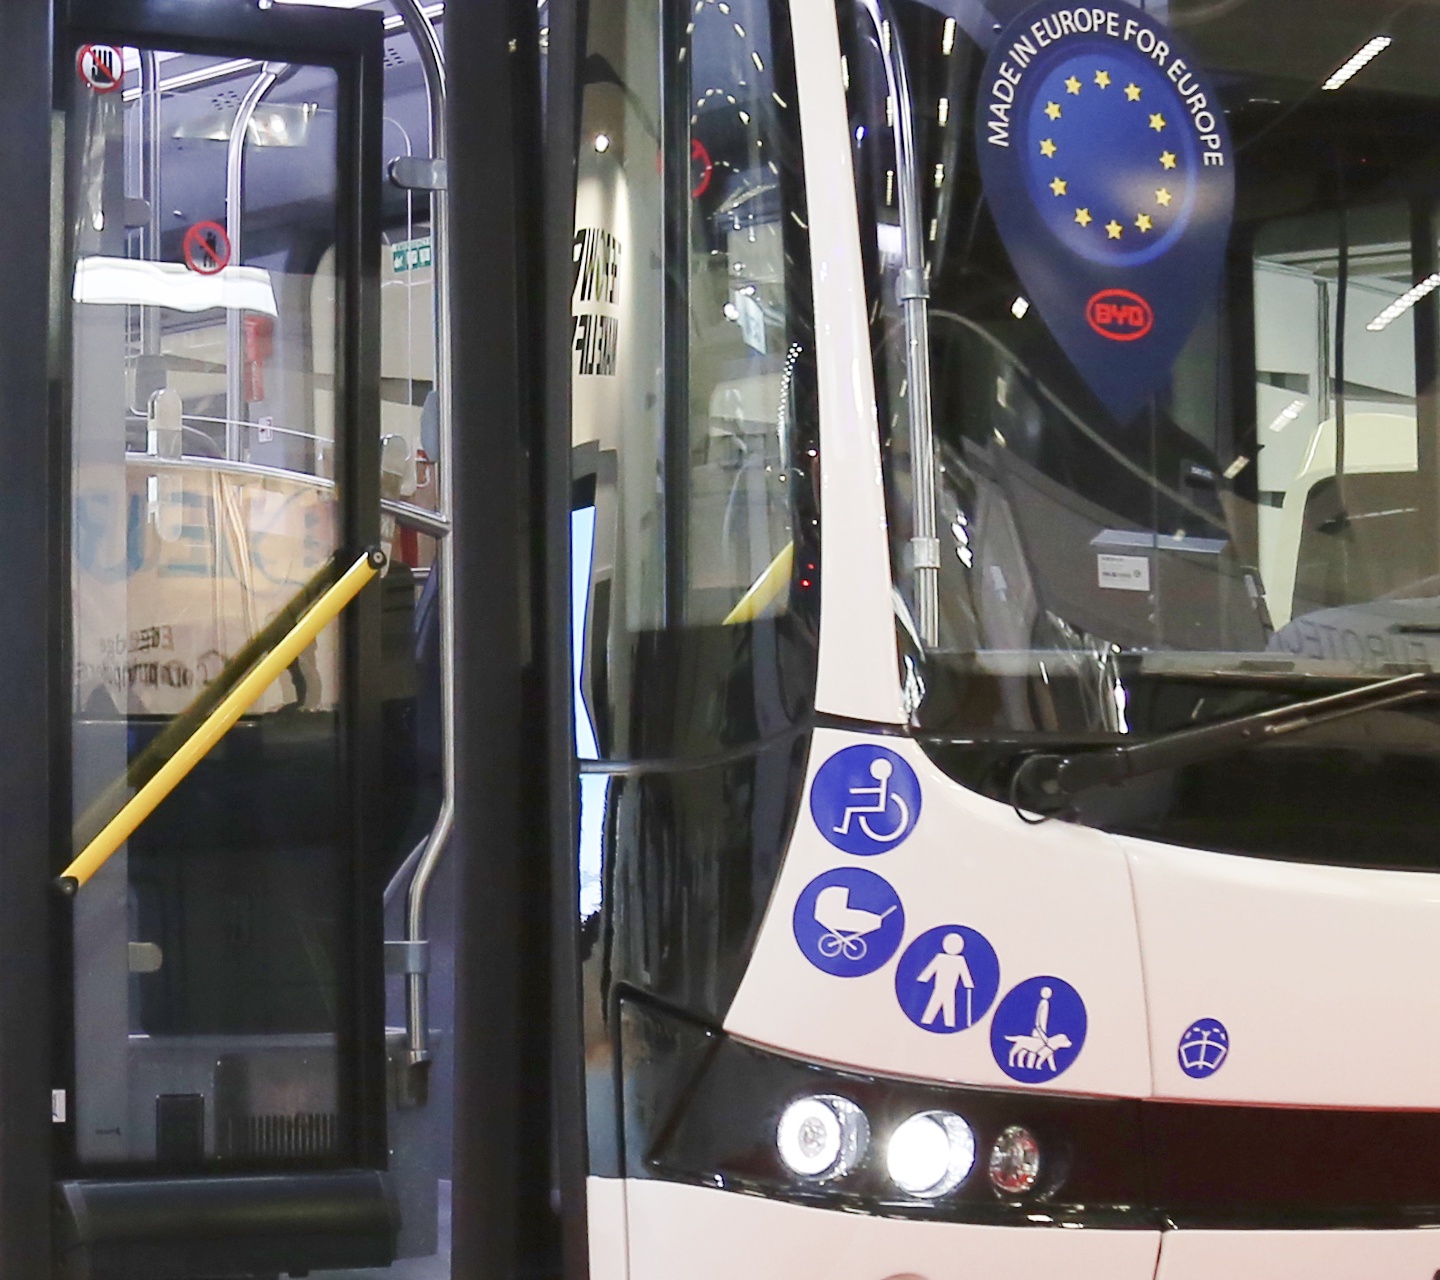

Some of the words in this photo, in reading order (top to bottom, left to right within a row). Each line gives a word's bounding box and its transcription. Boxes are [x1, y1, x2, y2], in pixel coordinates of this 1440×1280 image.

[987, 61, 1024, 148] MADE
[1008, 35, 1038, 68] IN
[1030, 7, 1120, 49] EUROPE
[1123, 18, 1171, 66] FOR
[1166, 58, 1225, 167] EUROPE
[1094, 302, 1145, 327] BYD
